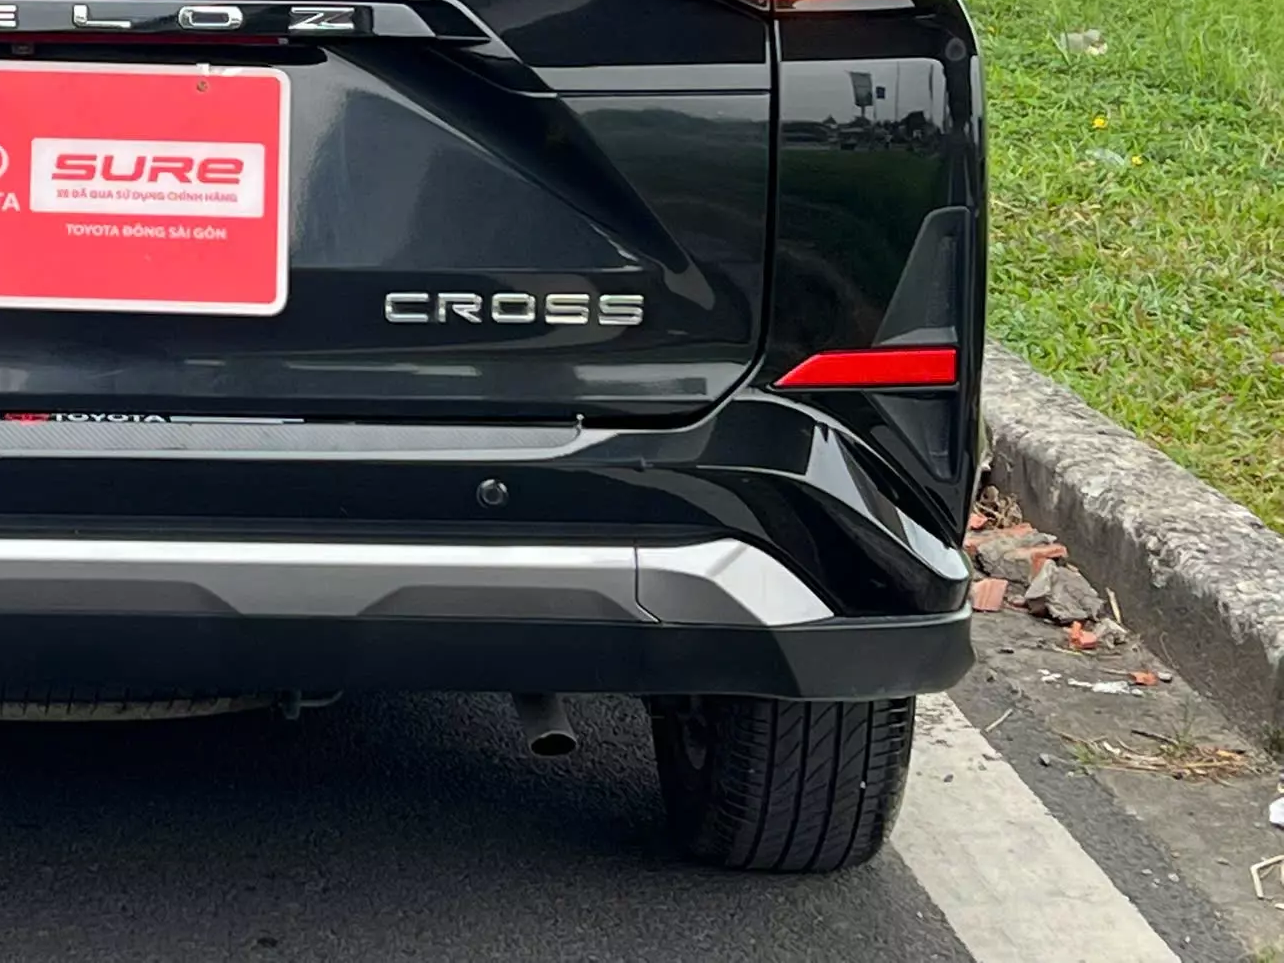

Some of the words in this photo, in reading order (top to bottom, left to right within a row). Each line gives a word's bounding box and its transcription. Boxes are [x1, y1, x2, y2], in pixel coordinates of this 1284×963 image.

[89, 189, 114, 200] QUA
[132, 190, 165, 202] DỤNG
[66, 223, 119, 237] TOYOTA
[121, 223, 166, 239] ĐÔNG
[168, 224, 191, 239] SÀI
[192, 224, 228, 240] GÒN
[385, 292, 644, 325] CROSS
[51, 412, 166, 423] TOYOTA
